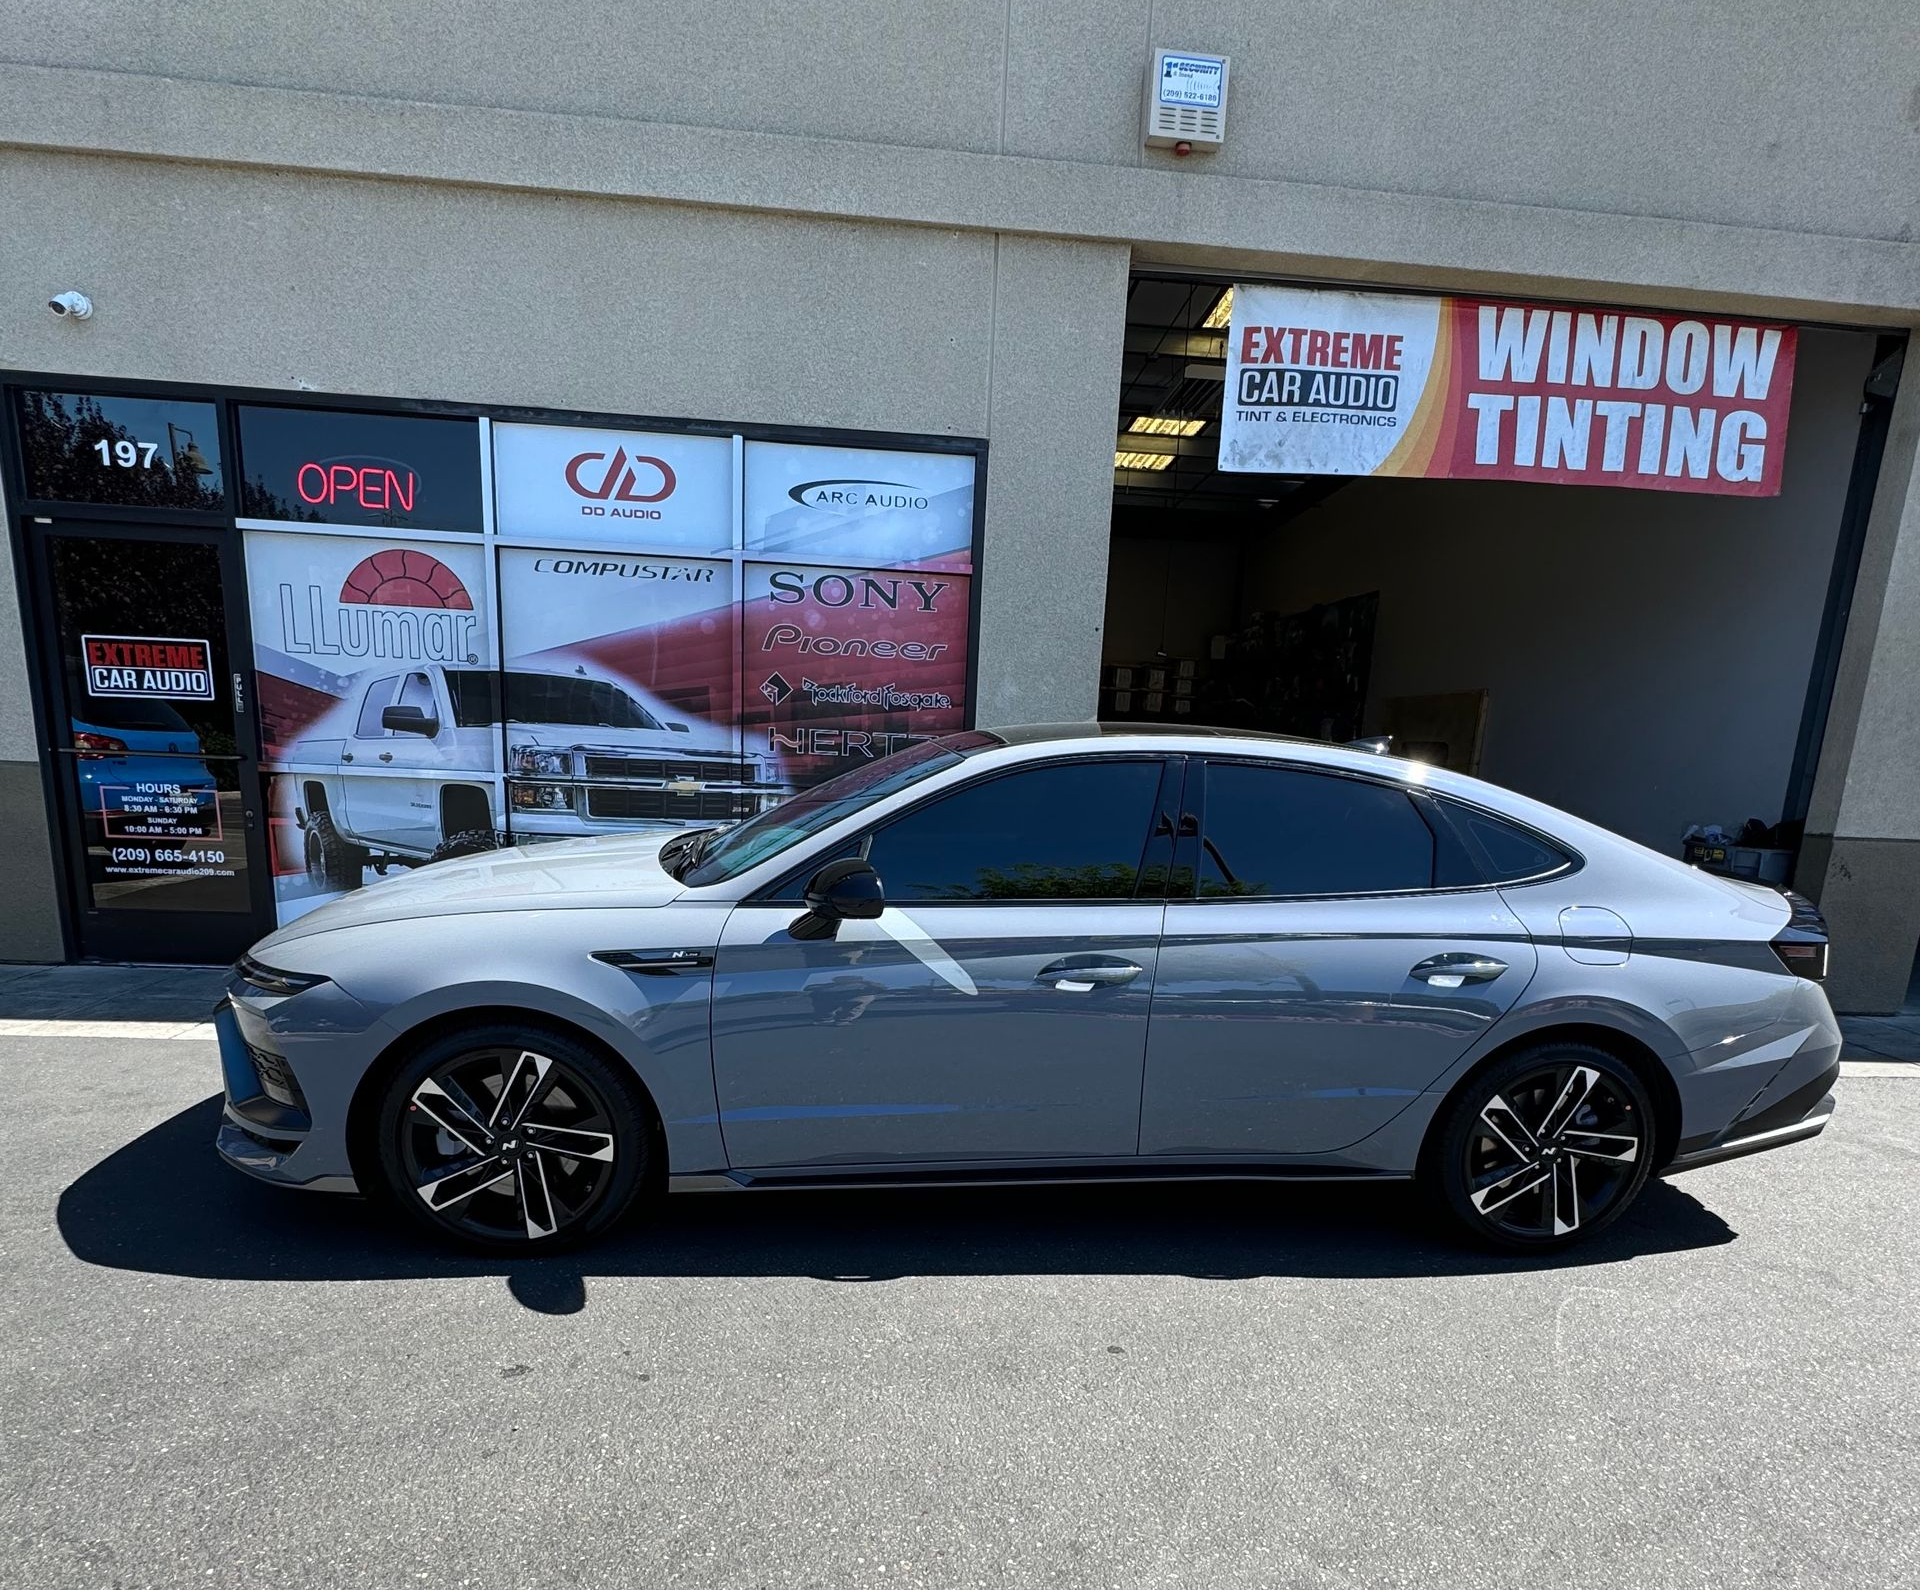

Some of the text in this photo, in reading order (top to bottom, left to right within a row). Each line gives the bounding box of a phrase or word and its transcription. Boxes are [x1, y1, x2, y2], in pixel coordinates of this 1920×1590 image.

[1240, 326, 1404, 371] EXTREME
[1478, 305, 1782, 400] WINDOW
[1240, 370, 1396, 409] CAR AUDIO
[1236, 410, 1397, 427] TINT & ELECTRONICS
[1467, 392, 1768, 482] TINTING
[94, 439, 159, 470] 197
[297, 462, 414, 512] OPEN
[815, 490, 929, 510] ARC AUDIO
[581, 505, 662, 520] DD AUDIO
[533, 557, 715, 583] COMPUSTAR
[769, 571, 949, 612] SONY
[761, 623, 948, 661] Pioneer
[87, 641, 205, 669] EXTREME
[94, 668, 206, 692] CAR AUDIO
[121, 795, 154, 803] MONDAY
[159, 796, 198, 804] SATURDAY
[136, 782, 181, 794] HOURS
[124, 804, 142, 813] 8:30
[143, 805, 158, 813] AM
[164, 806, 183, 814] 6:30
[184, 806, 198, 814] PM
[147, 817, 177, 825] SUNDAY
[124, 825, 147, 833] 10:00
[148, 826, 163, 834] AM
[169, 826, 187, 834] 5:00
[189, 827, 202, 835] PM
[112, 847, 225, 864] (209) 665-4150
[105, 866, 235, 877] www.extremecaraudio209.com
